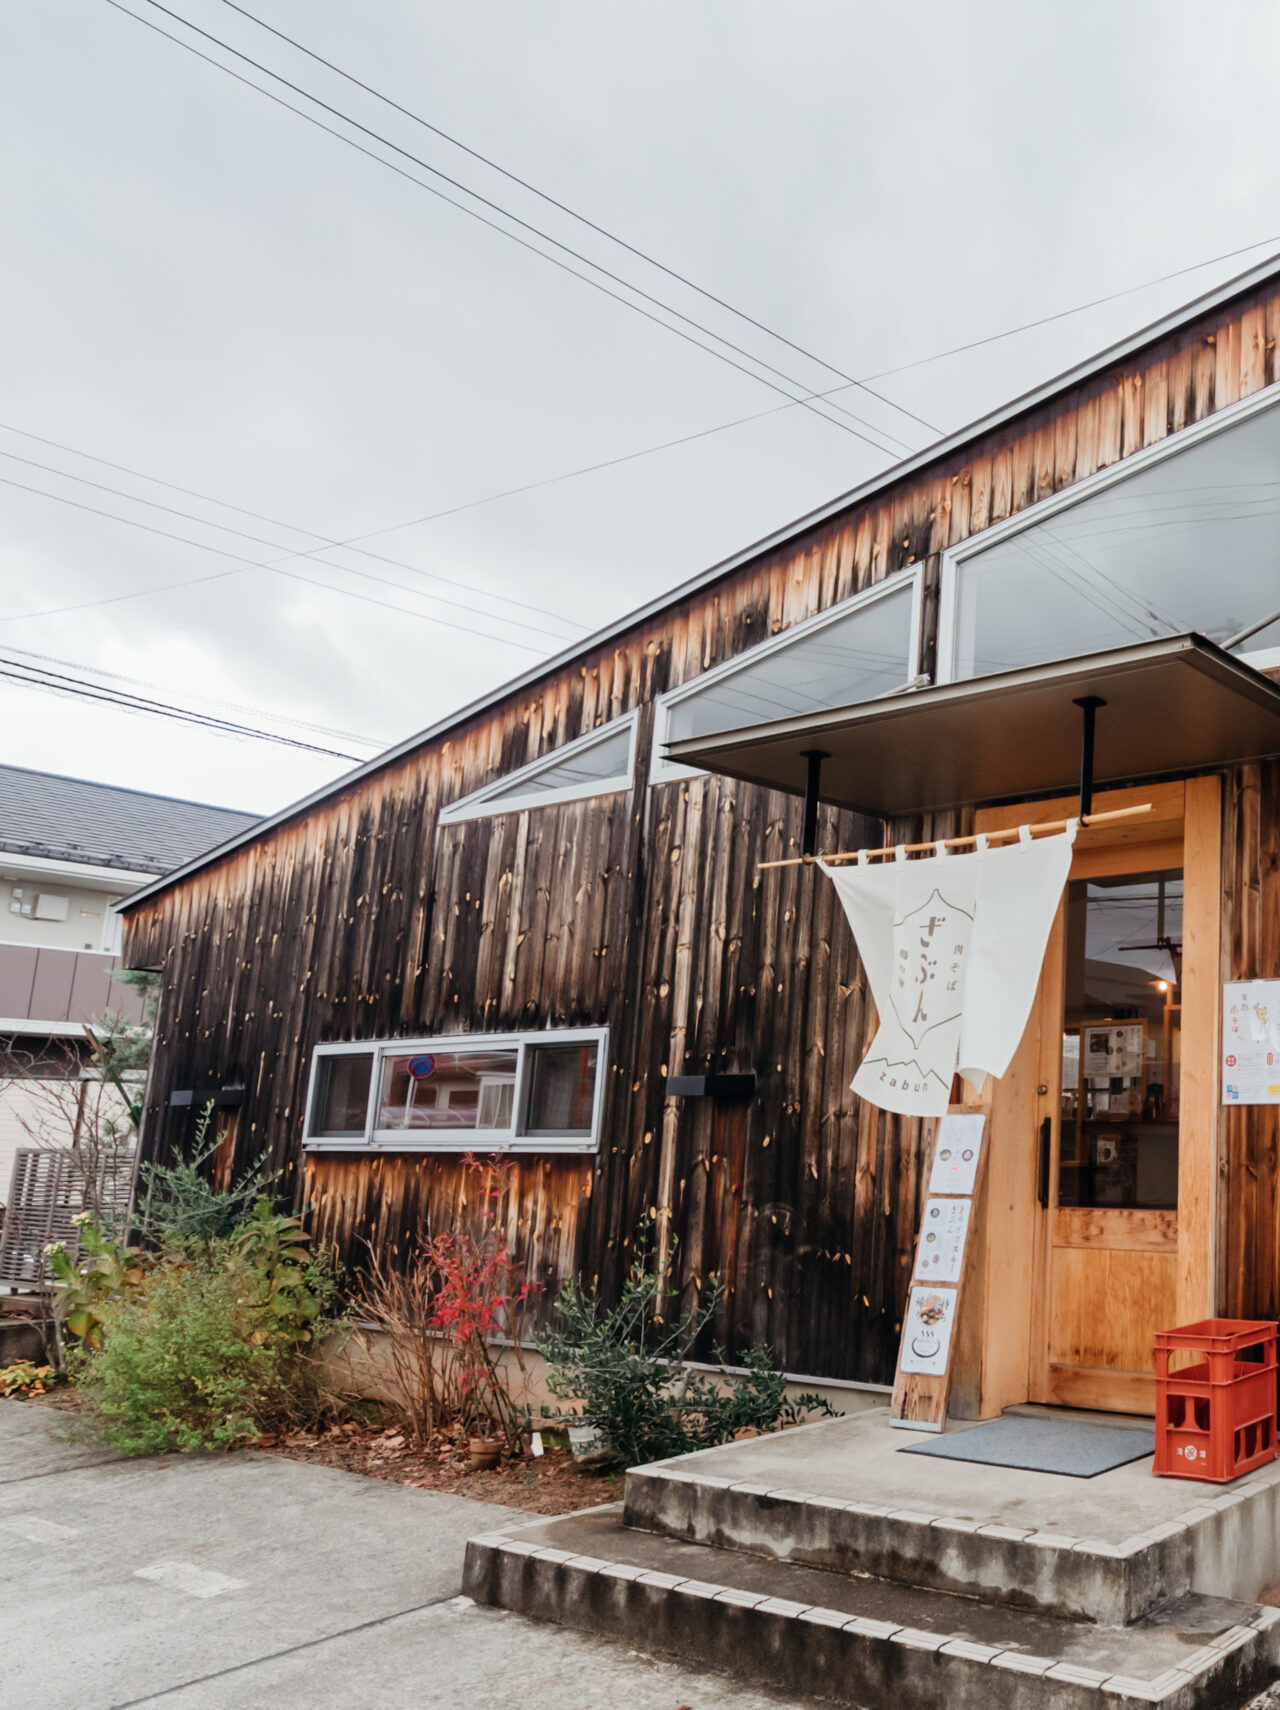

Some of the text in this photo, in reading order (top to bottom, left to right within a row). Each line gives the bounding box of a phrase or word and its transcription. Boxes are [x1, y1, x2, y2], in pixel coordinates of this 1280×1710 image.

[912, 916, 946, 1023] ざぶん
[879, 1072, 928, 1092] zabun
